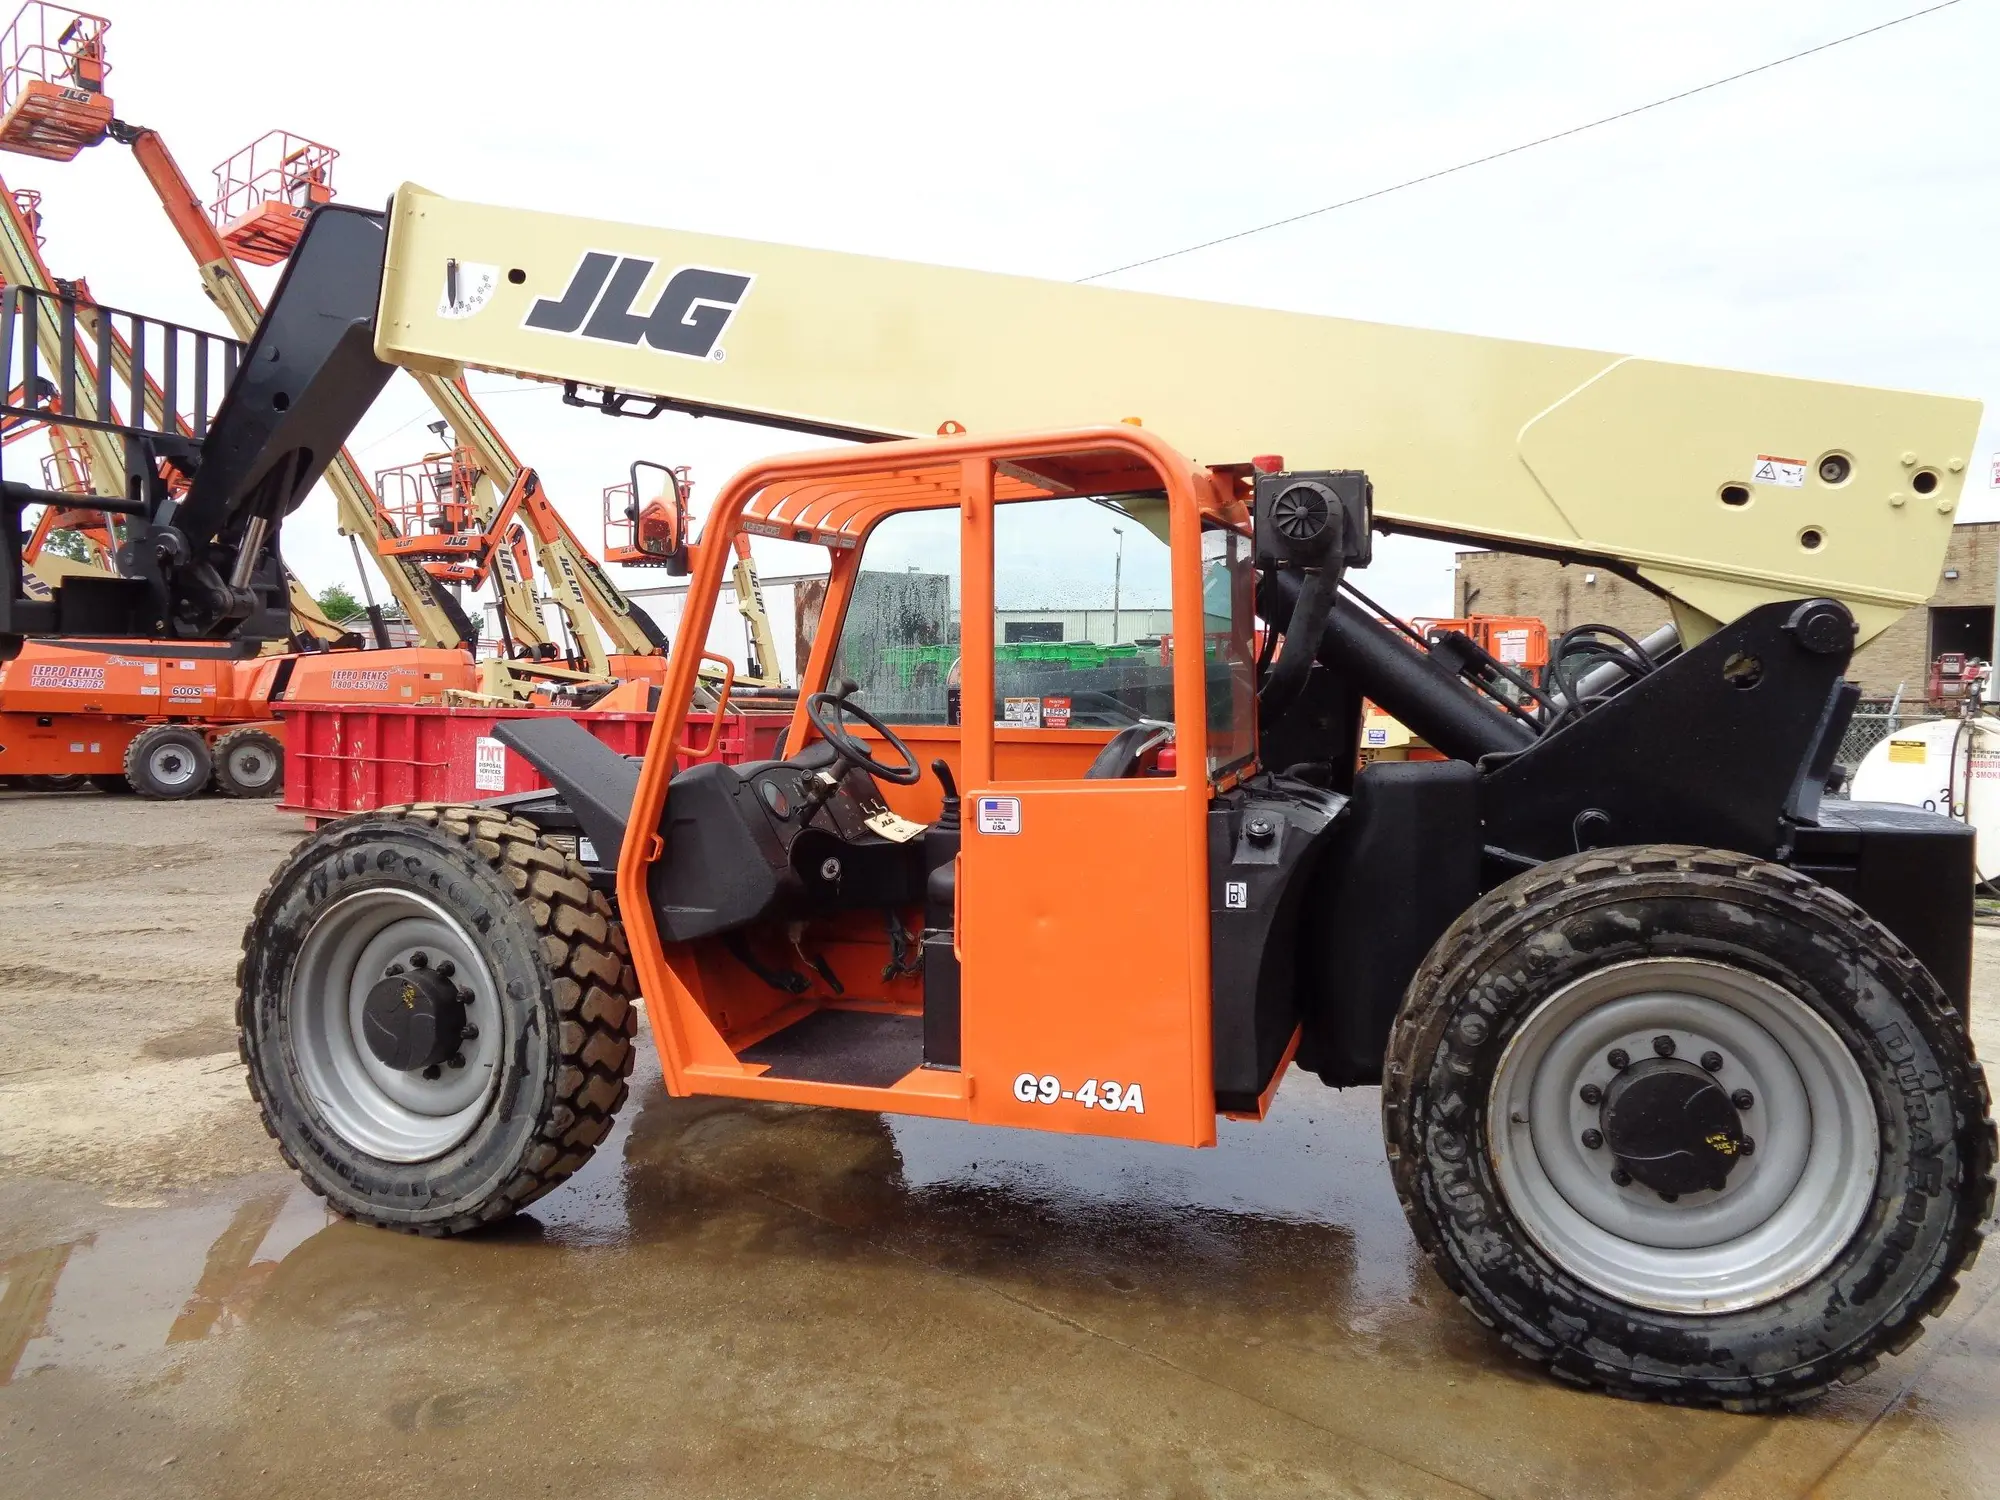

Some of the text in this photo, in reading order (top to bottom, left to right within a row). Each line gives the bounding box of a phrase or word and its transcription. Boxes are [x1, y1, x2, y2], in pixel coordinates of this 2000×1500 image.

[58, 88, 91, 103] JLG
[522, 250, 754, 360] JLG
[444, 536, 468, 546] JLG
[447, 565, 464, 574] JLG
[498, 548, 517, 583] LIFT
[559, 555, 585, 604] JLG LIFT
[749, 568, 765, 615] JLG LIFT
[535, 606, 545, 626] LIFT
[32, 666, 105, 679] LEPPO RENTS
[332, 670, 358, 681] LEPPO
[361, 670, 389, 681] RENTS
[172, 686, 202, 697] 600S
[478, 745, 504, 762] TNT
[881, 818, 895, 828] JLG
[1230, 893, 1238, 902] D
[1013, 1072, 1146, 1115] G9-43A
